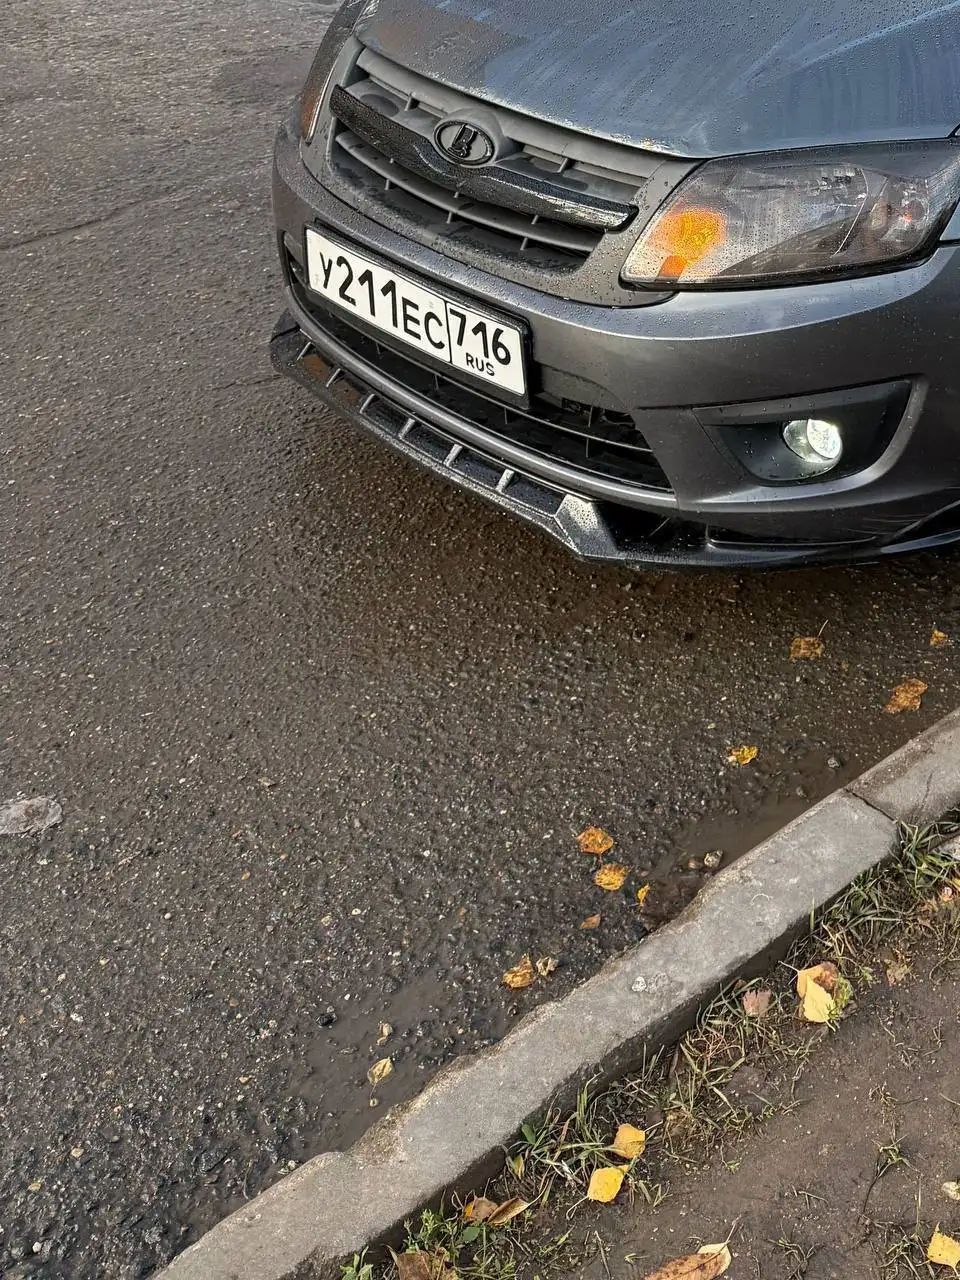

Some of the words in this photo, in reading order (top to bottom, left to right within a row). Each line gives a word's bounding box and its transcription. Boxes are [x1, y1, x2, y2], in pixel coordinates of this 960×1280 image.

[319, 251, 446, 349] У211ЕС
[449, 307, 512, 366] 716
[465, 352, 496, 377] RUS
